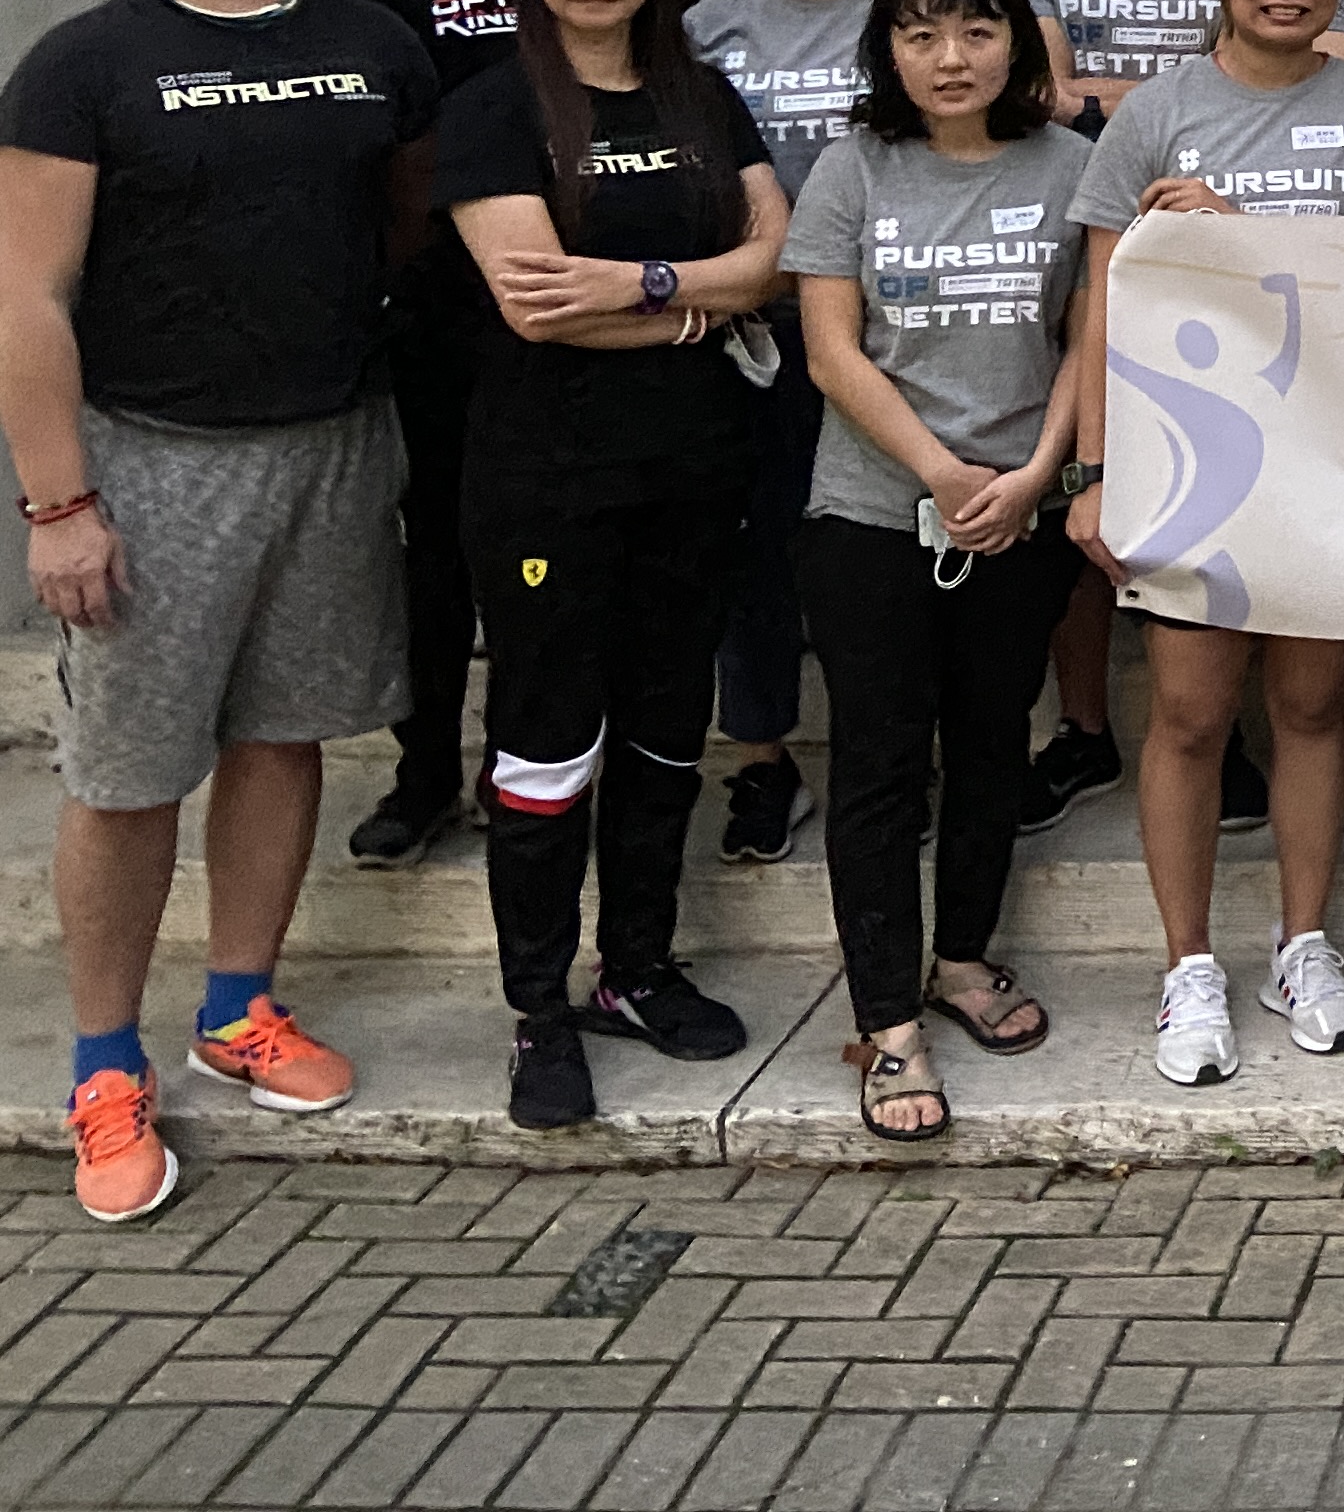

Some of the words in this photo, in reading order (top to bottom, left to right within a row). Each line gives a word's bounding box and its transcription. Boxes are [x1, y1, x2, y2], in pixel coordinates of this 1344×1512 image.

[161, 73, 368, 111] INSTRUCTOR
[875, 241, 1059, 271] PURSUIT
[877, 275, 930, 300] OF
[881, 299, 1040, 329] BETTER
